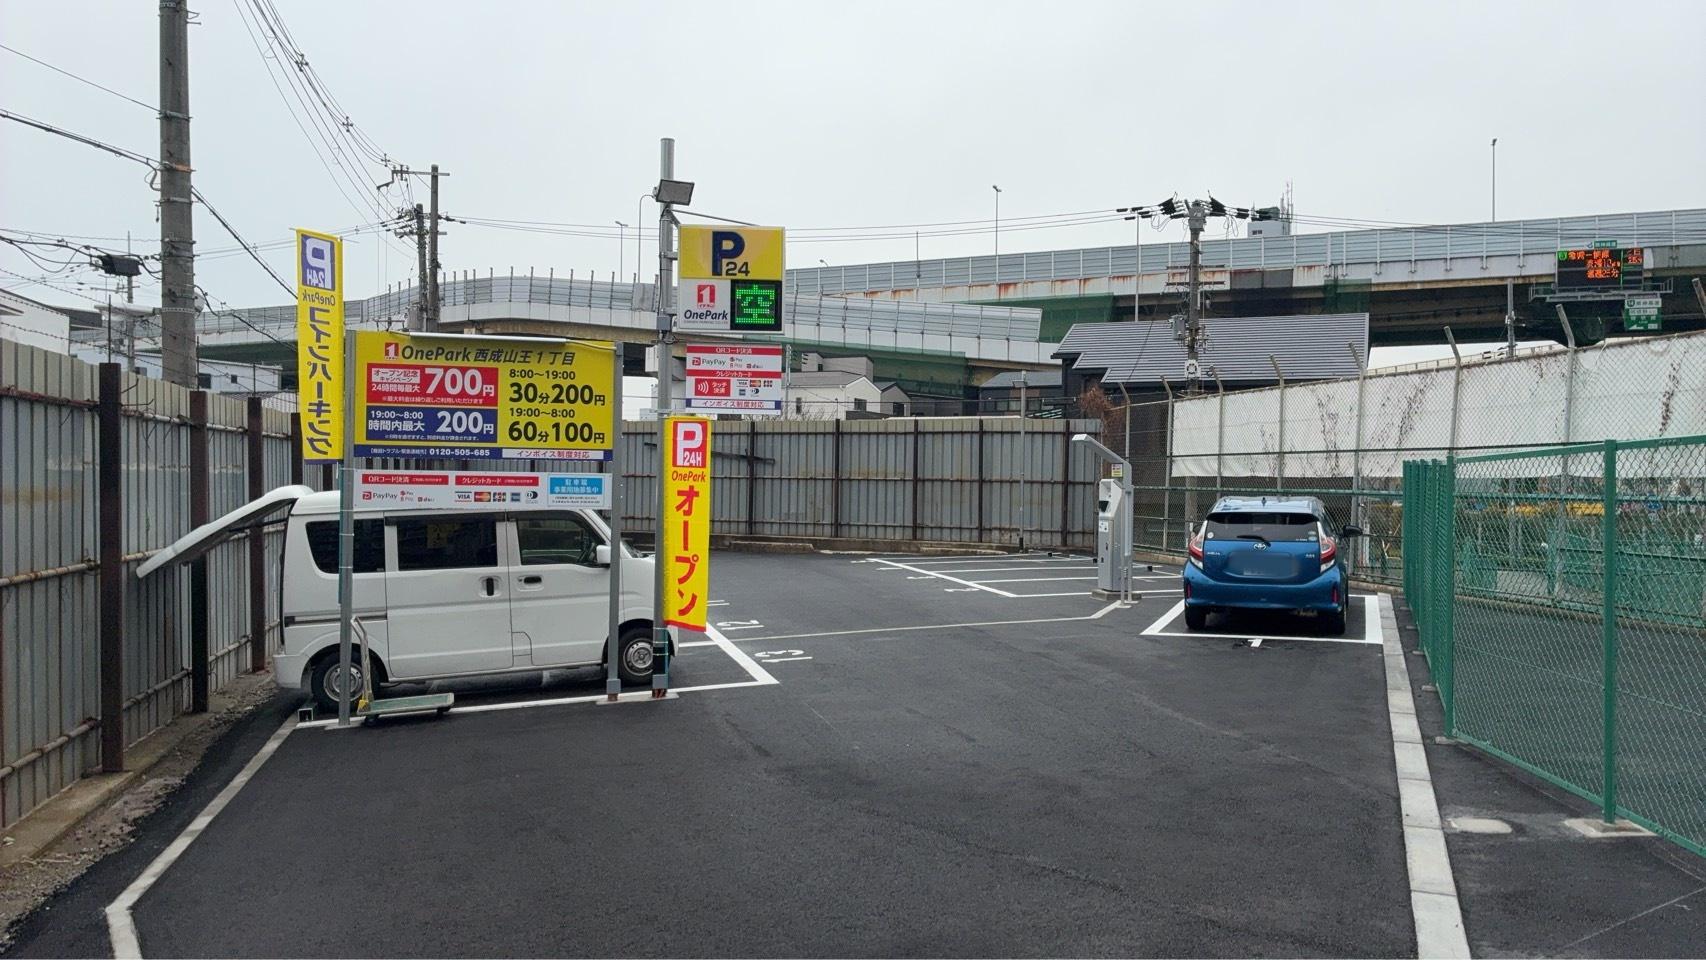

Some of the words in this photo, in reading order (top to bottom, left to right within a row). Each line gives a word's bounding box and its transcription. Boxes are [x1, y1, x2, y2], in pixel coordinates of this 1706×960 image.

[711, 230, 746, 277] P
[725, 261, 751, 277] 24
[735, 284, 775, 325] 空
[683, 309, 729, 321] OnePark
[401, 345, 471, 362] OnePark
[371, 383, 420, 393] 24時間毎最大
[424, 367, 495, 397] 700円
[508, 382, 606, 406] 30分200円
[702, 400, 765, 409] インボイス制度対応
[367, 420, 425, 432] 時間内最大
[435, 410, 494, 435] 200円
[507, 420, 605, 444] 60分100円
[429, 448, 491, 457] 0120-505-685
[676, 422, 703, 467] P
[516, 450, 590, 459] インボイス制度対応
[683, 450, 703, 467] 24H
[462, 477, 502, 485] クレジットカード
[671, 470, 706, 483] OnePark
[674, 484, 700, 617] オープン
